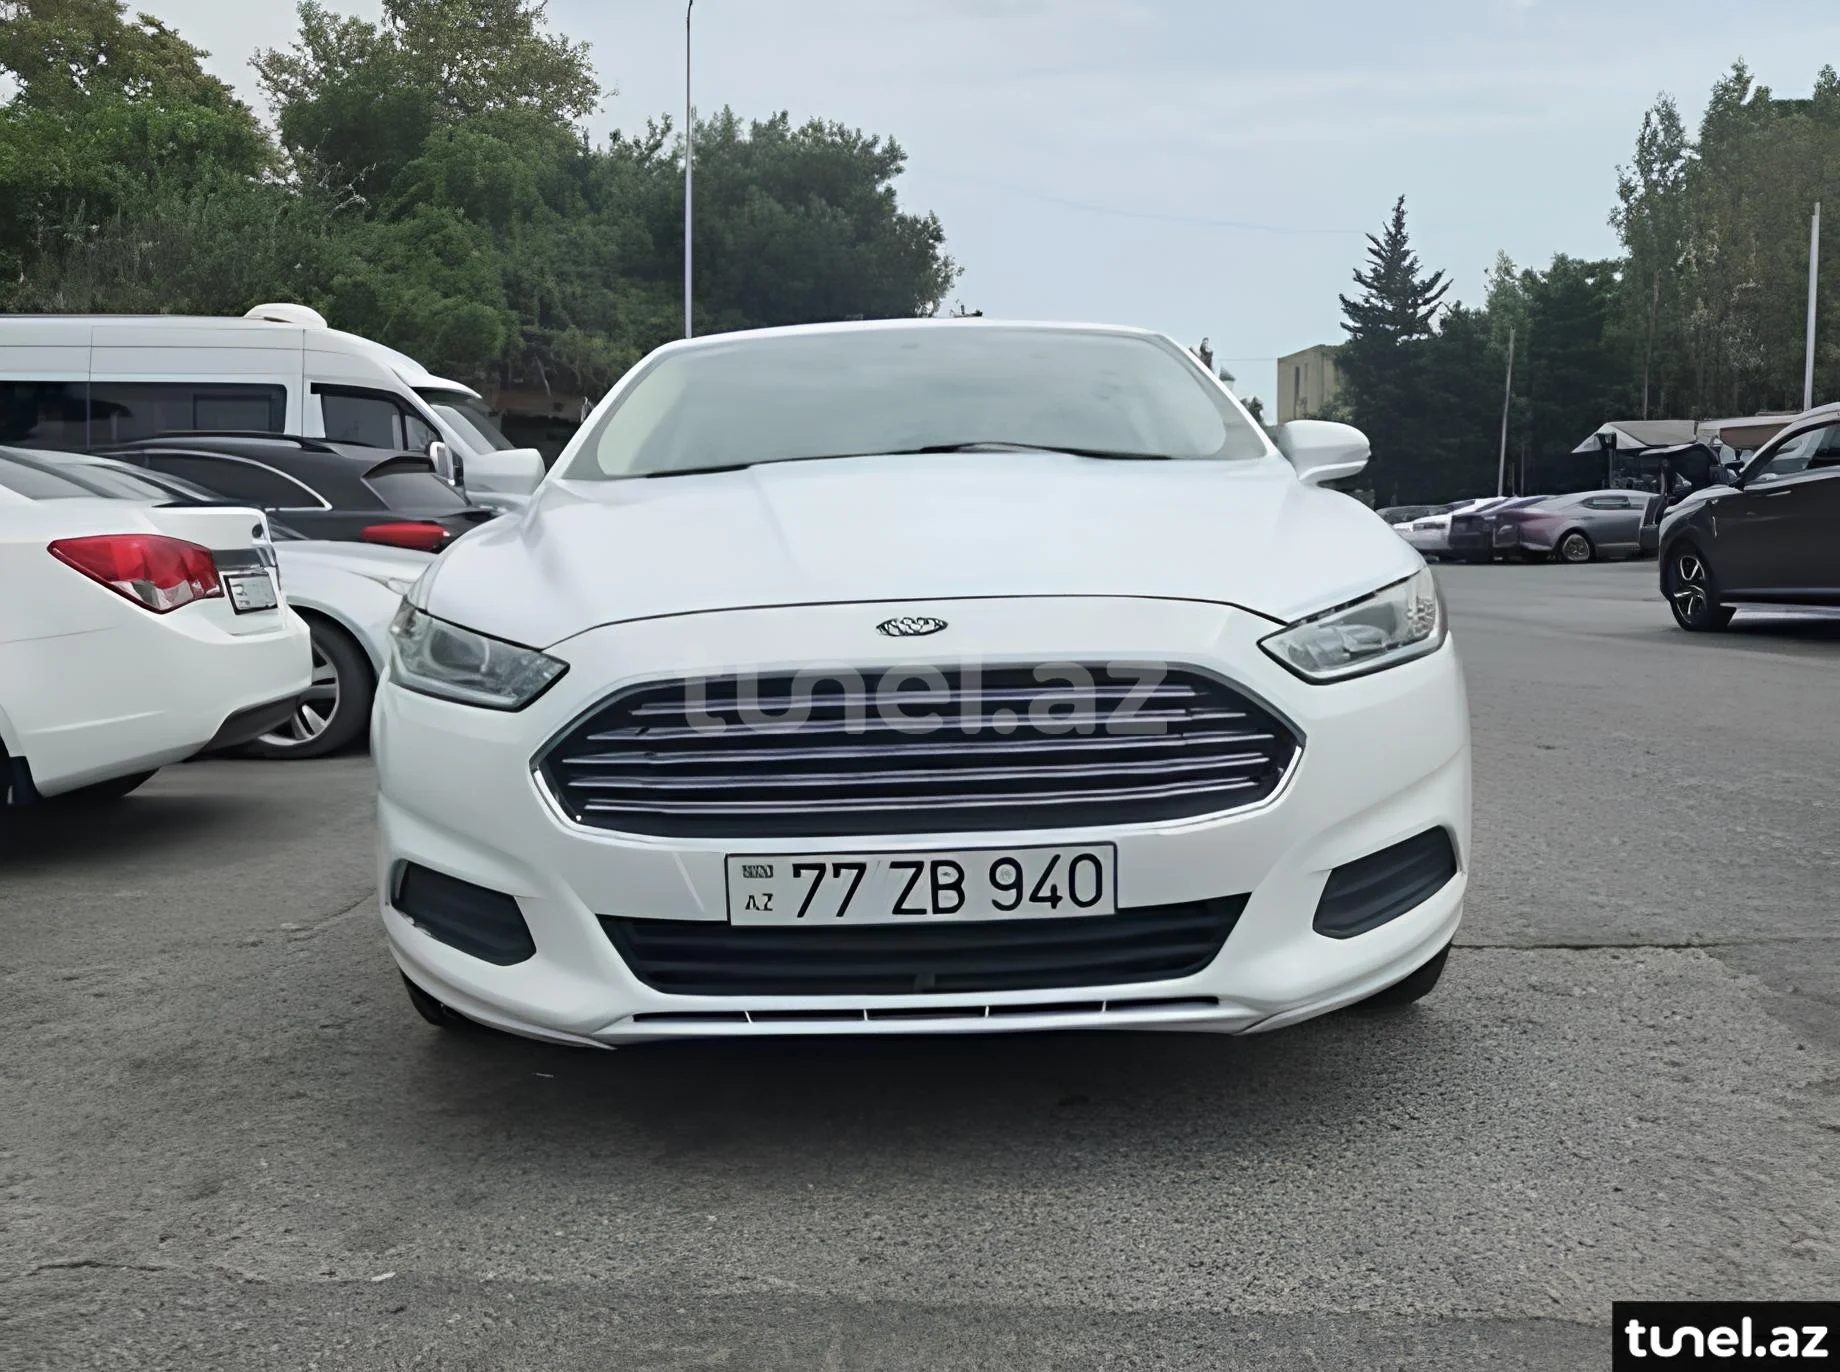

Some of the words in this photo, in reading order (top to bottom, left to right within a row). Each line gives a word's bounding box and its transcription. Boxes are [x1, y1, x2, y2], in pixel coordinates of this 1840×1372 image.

[745, 893, 774, 911] AZ
[792, 862, 866, 918] 77
[889, 860, 965, 915] ZB
[989, 853, 1103, 911] 940
